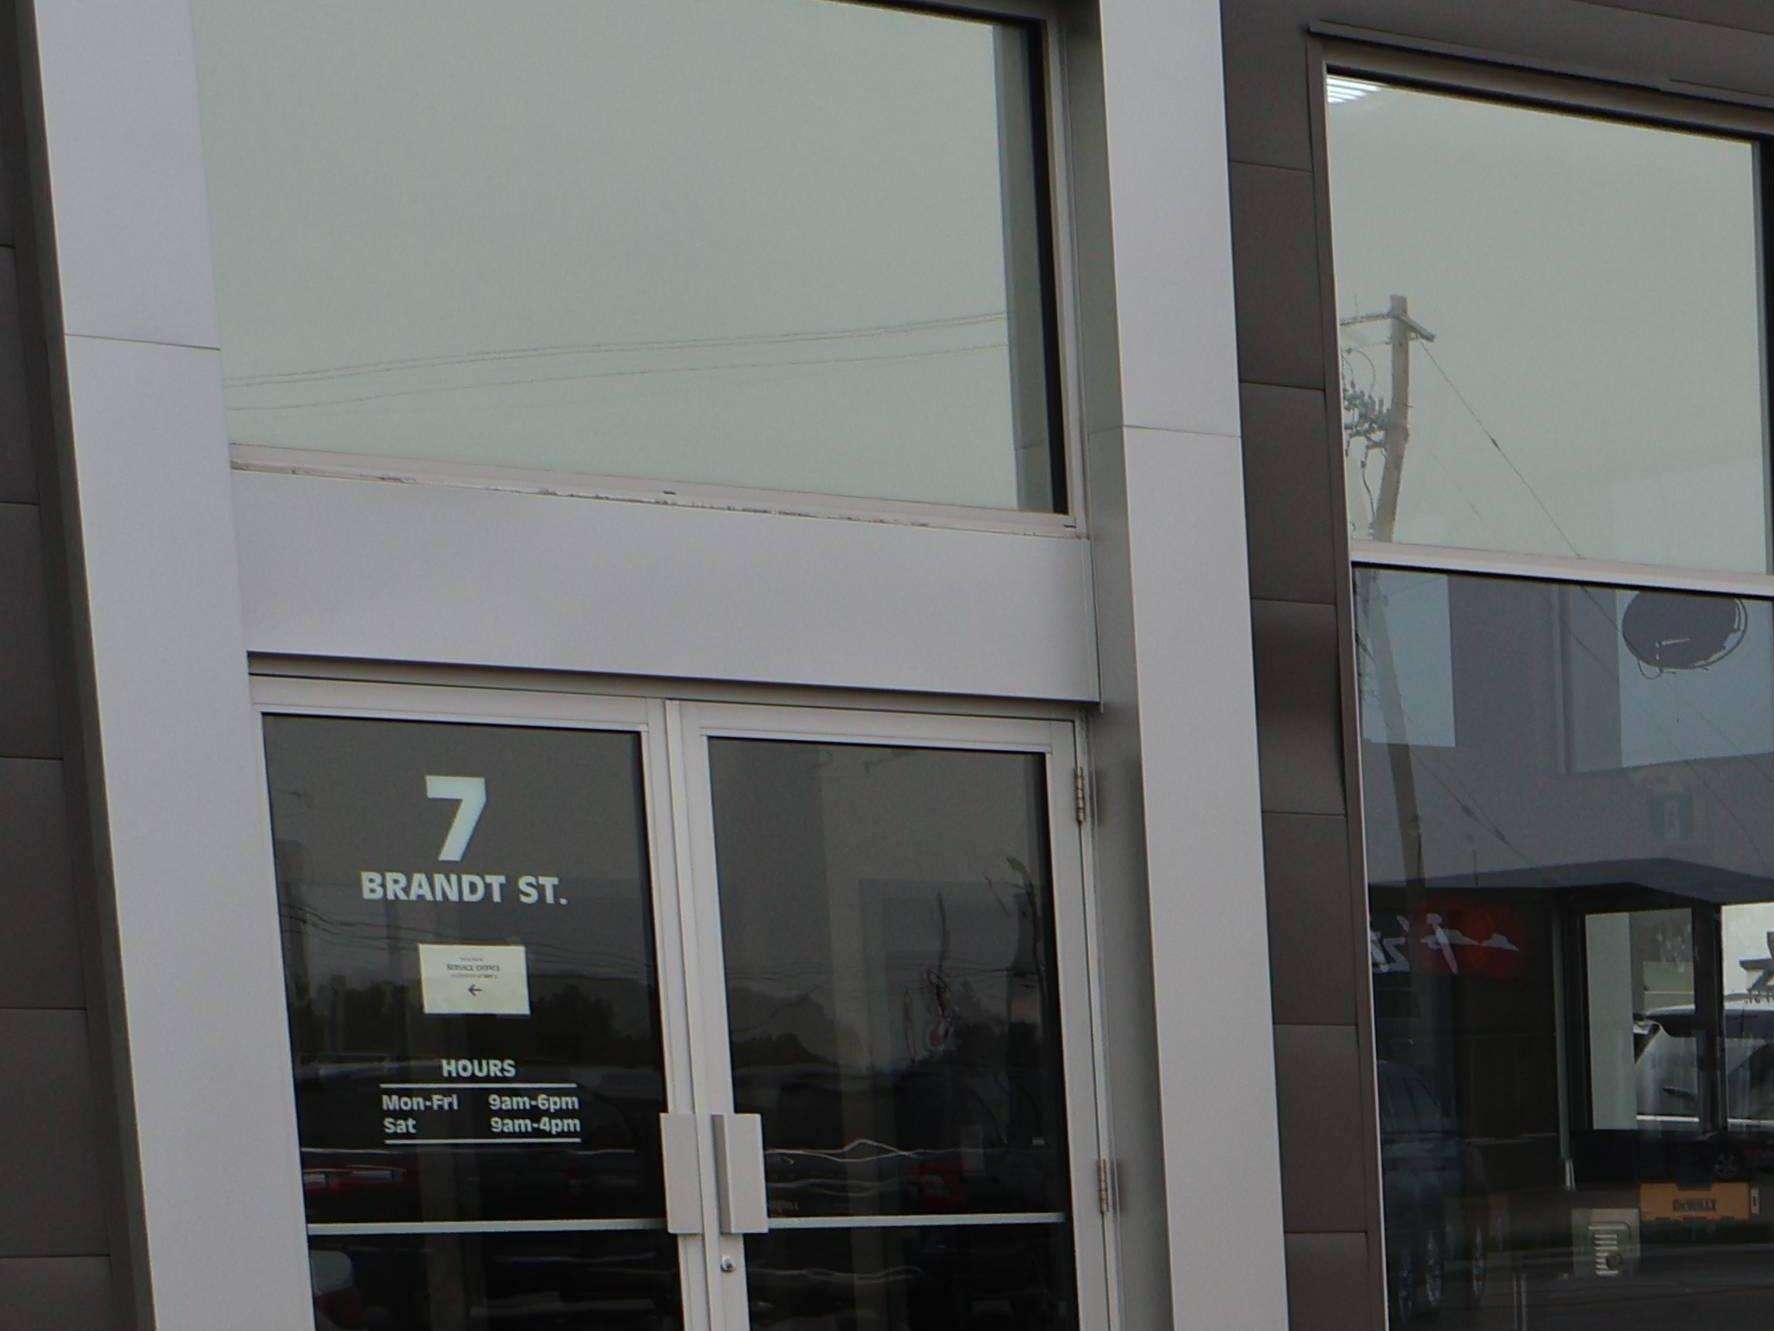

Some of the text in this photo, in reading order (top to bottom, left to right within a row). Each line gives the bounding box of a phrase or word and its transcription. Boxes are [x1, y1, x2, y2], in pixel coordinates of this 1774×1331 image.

[424, 774, 488, 862] 7
[361, 871, 568, 906] BRANDT ST.
[441, 1058, 516, 1078] HOURS
[382, 1094, 580, 1113] Mon-Fri 9am-6pm
[383, 1117, 581, 1135] Sat 9am-4pm
